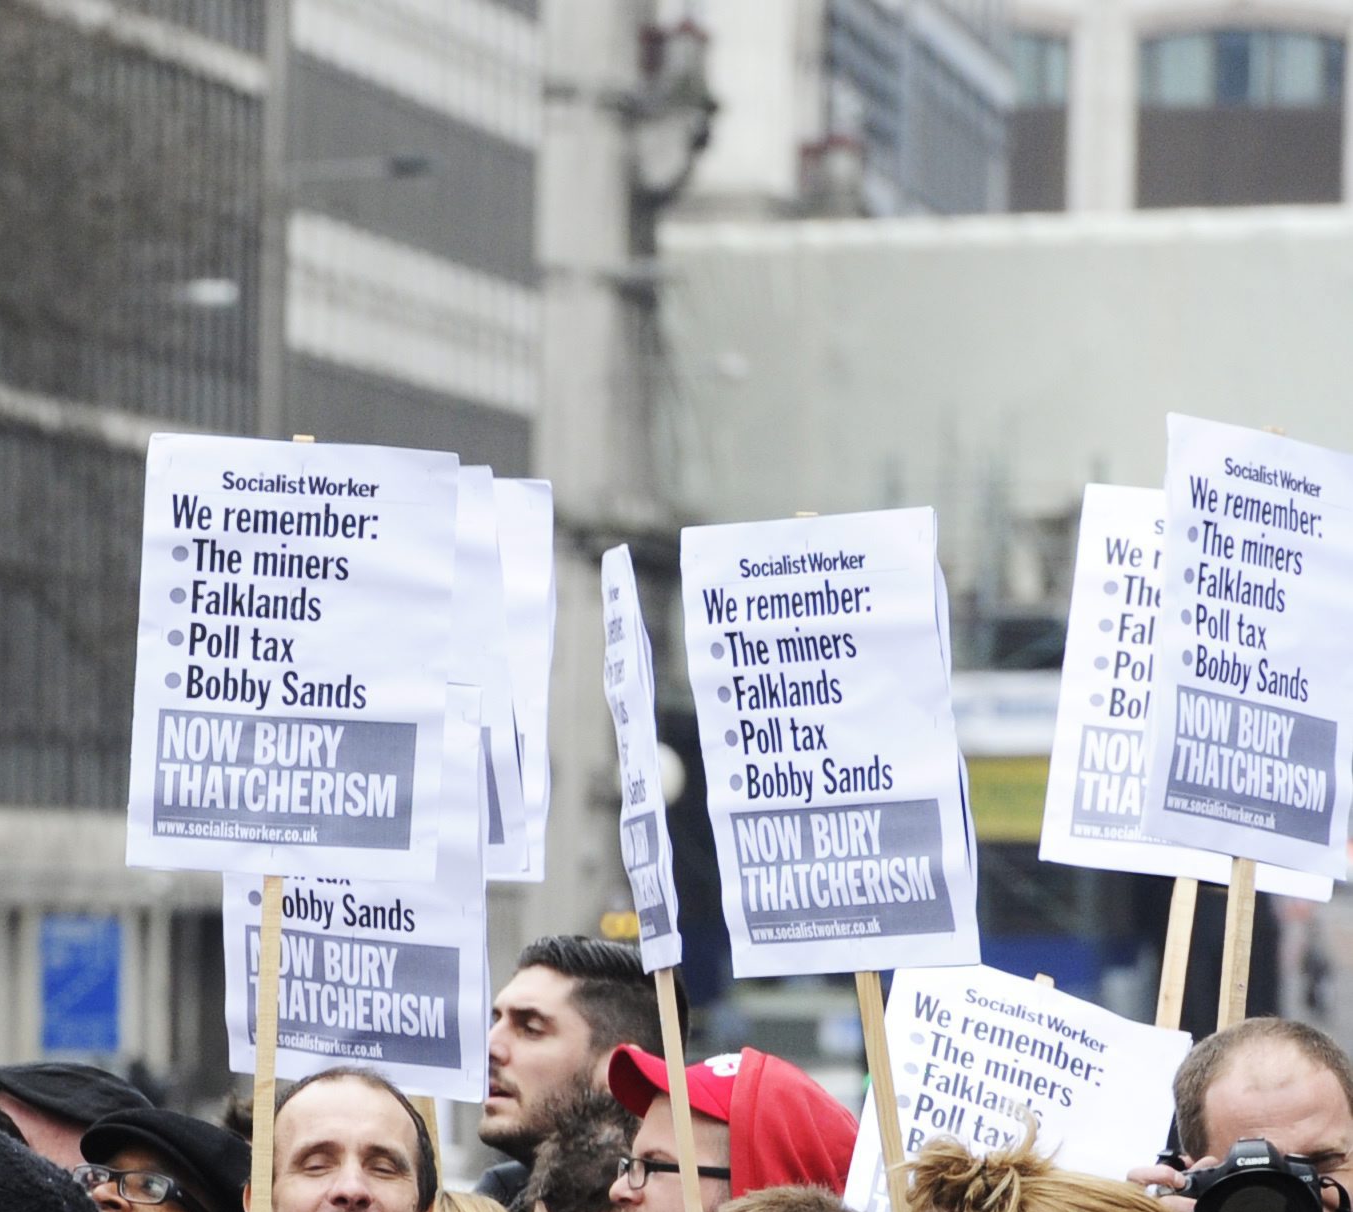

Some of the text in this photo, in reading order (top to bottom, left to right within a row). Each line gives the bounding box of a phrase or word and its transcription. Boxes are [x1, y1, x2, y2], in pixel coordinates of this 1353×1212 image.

[172, 494, 379, 540] We remember:
[1189, 474, 1323, 538] We remember:
[193, 538, 349, 581] The miners
[1106, 537, 1142, 567] We
[1202, 520, 1234, 555] The
[1241, 532, 1303, 576] miners
[191, 580, 321, 622] Falklands
[702, 580, 872, 624] We remember:
[1197, 562, 1285, 613] Falklands
[189, 622, 294, 663] Poll tax
[724, 627, 856, 667] The miners
[1195, 603, 1229, 644] Poll
[1237, 613, 1267, 651] tax
[186, 665, 366, 710] Bobby Sands
[732, 669, 842, 711] Falklands
[1195, 644, 1308, 702] Bobby Sands
[162, 715, 344, 769] NOW BURY
[741, 717, 828, 755] Poll tax
[1179, 691, 1233, 742] NOW
[1237, 700, 1294, 759] BURY
[159, 762, 397, 818] THATCHERISM
[746, 755, 893, 803] Bobby Sands
[1175, 738, 1327, 813] THATCHERISM
[156, 819, 318, 843] www.socialistworker.co.uk
[1166, 793, 1276, 830] www.socialistworker.co.uk
[736, 809, 881, 863] NOW BURY
[741, 855, 936, 912] THATCHERISM
[283, 887, 415, 932] obby Sands
[751, 914, 881, 942] www.socialistworker.co.uk
[323, 940, 398, 989] BURY
[914, 991, 1104, 1087] We remember:
[930, 1031, 1073, 1108] The miners
[914, 1093, 1018, 1150] Poll tax
